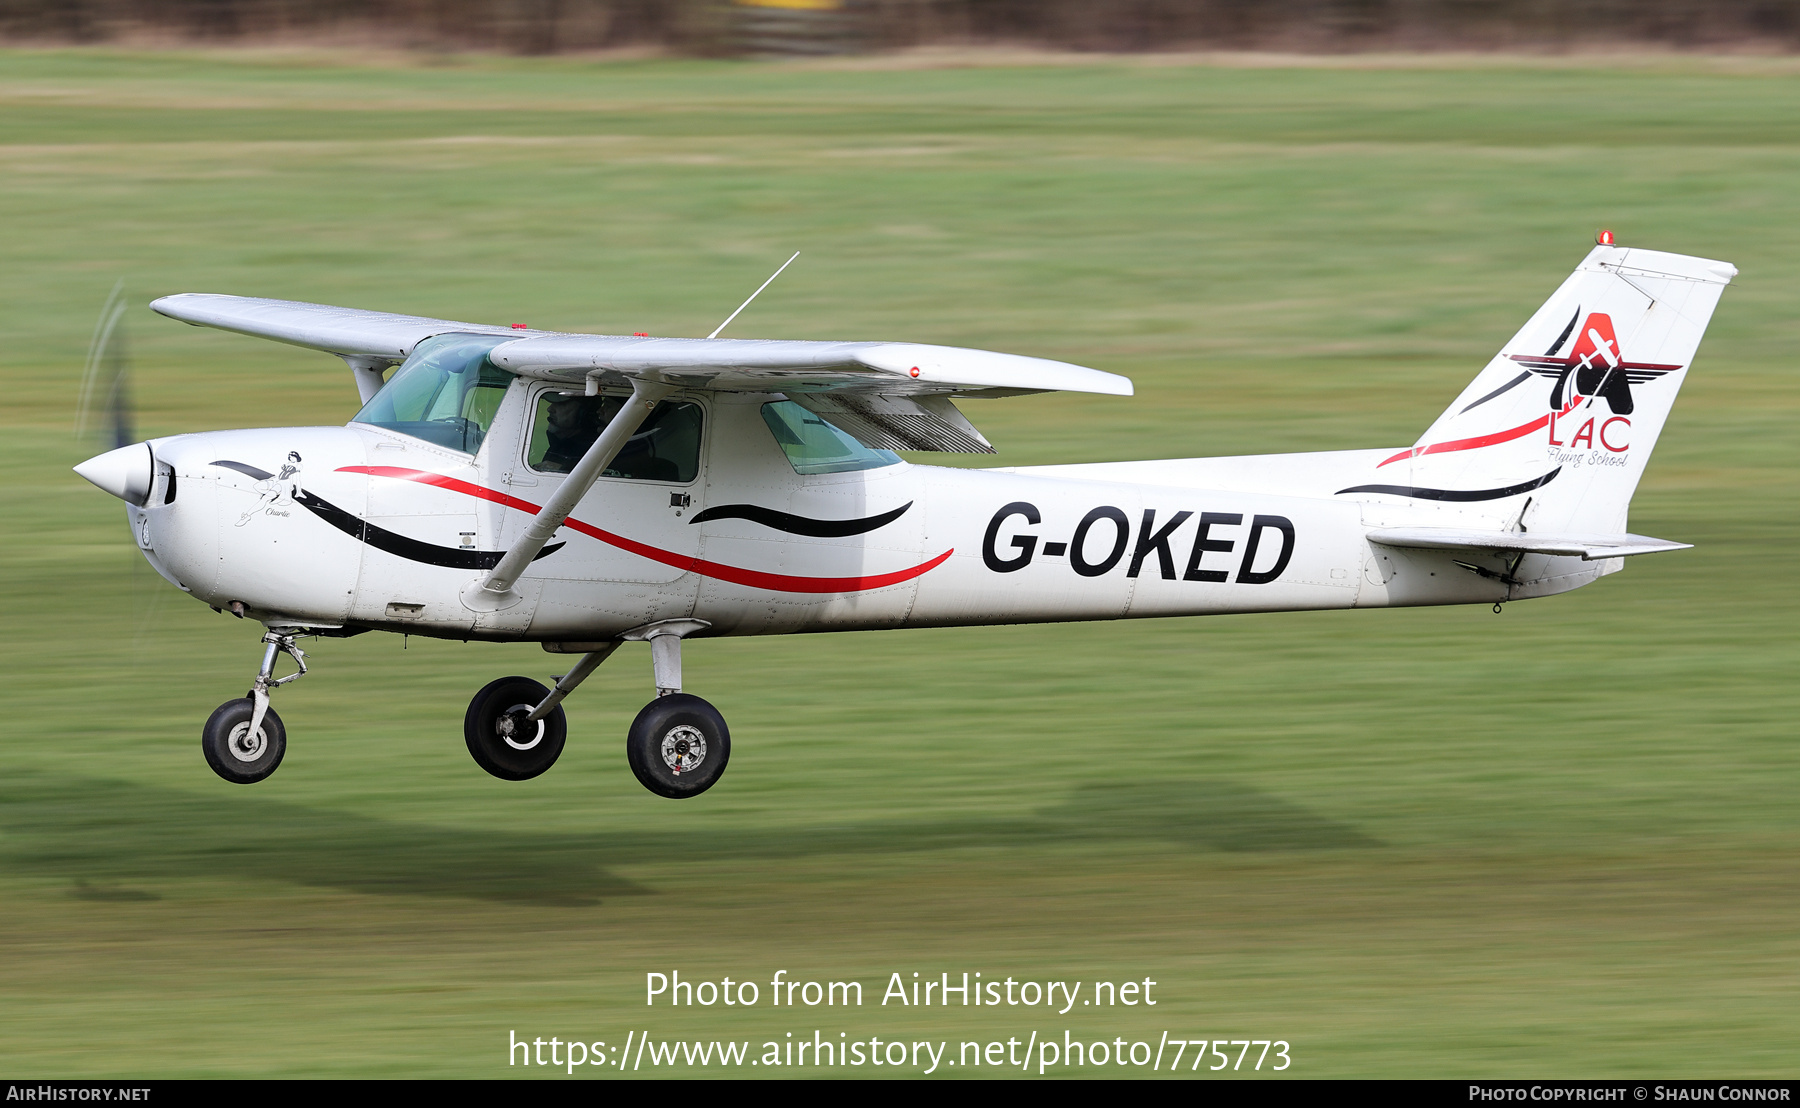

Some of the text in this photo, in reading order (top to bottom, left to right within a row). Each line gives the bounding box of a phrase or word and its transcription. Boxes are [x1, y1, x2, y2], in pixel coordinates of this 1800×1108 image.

[1549, 412, 1631, 452] LAC
[1547, 446, 1629, 468] Flying School
[265, 507, 290, 518] Charlie
[982, 502, 1295, 584] G-OKED
